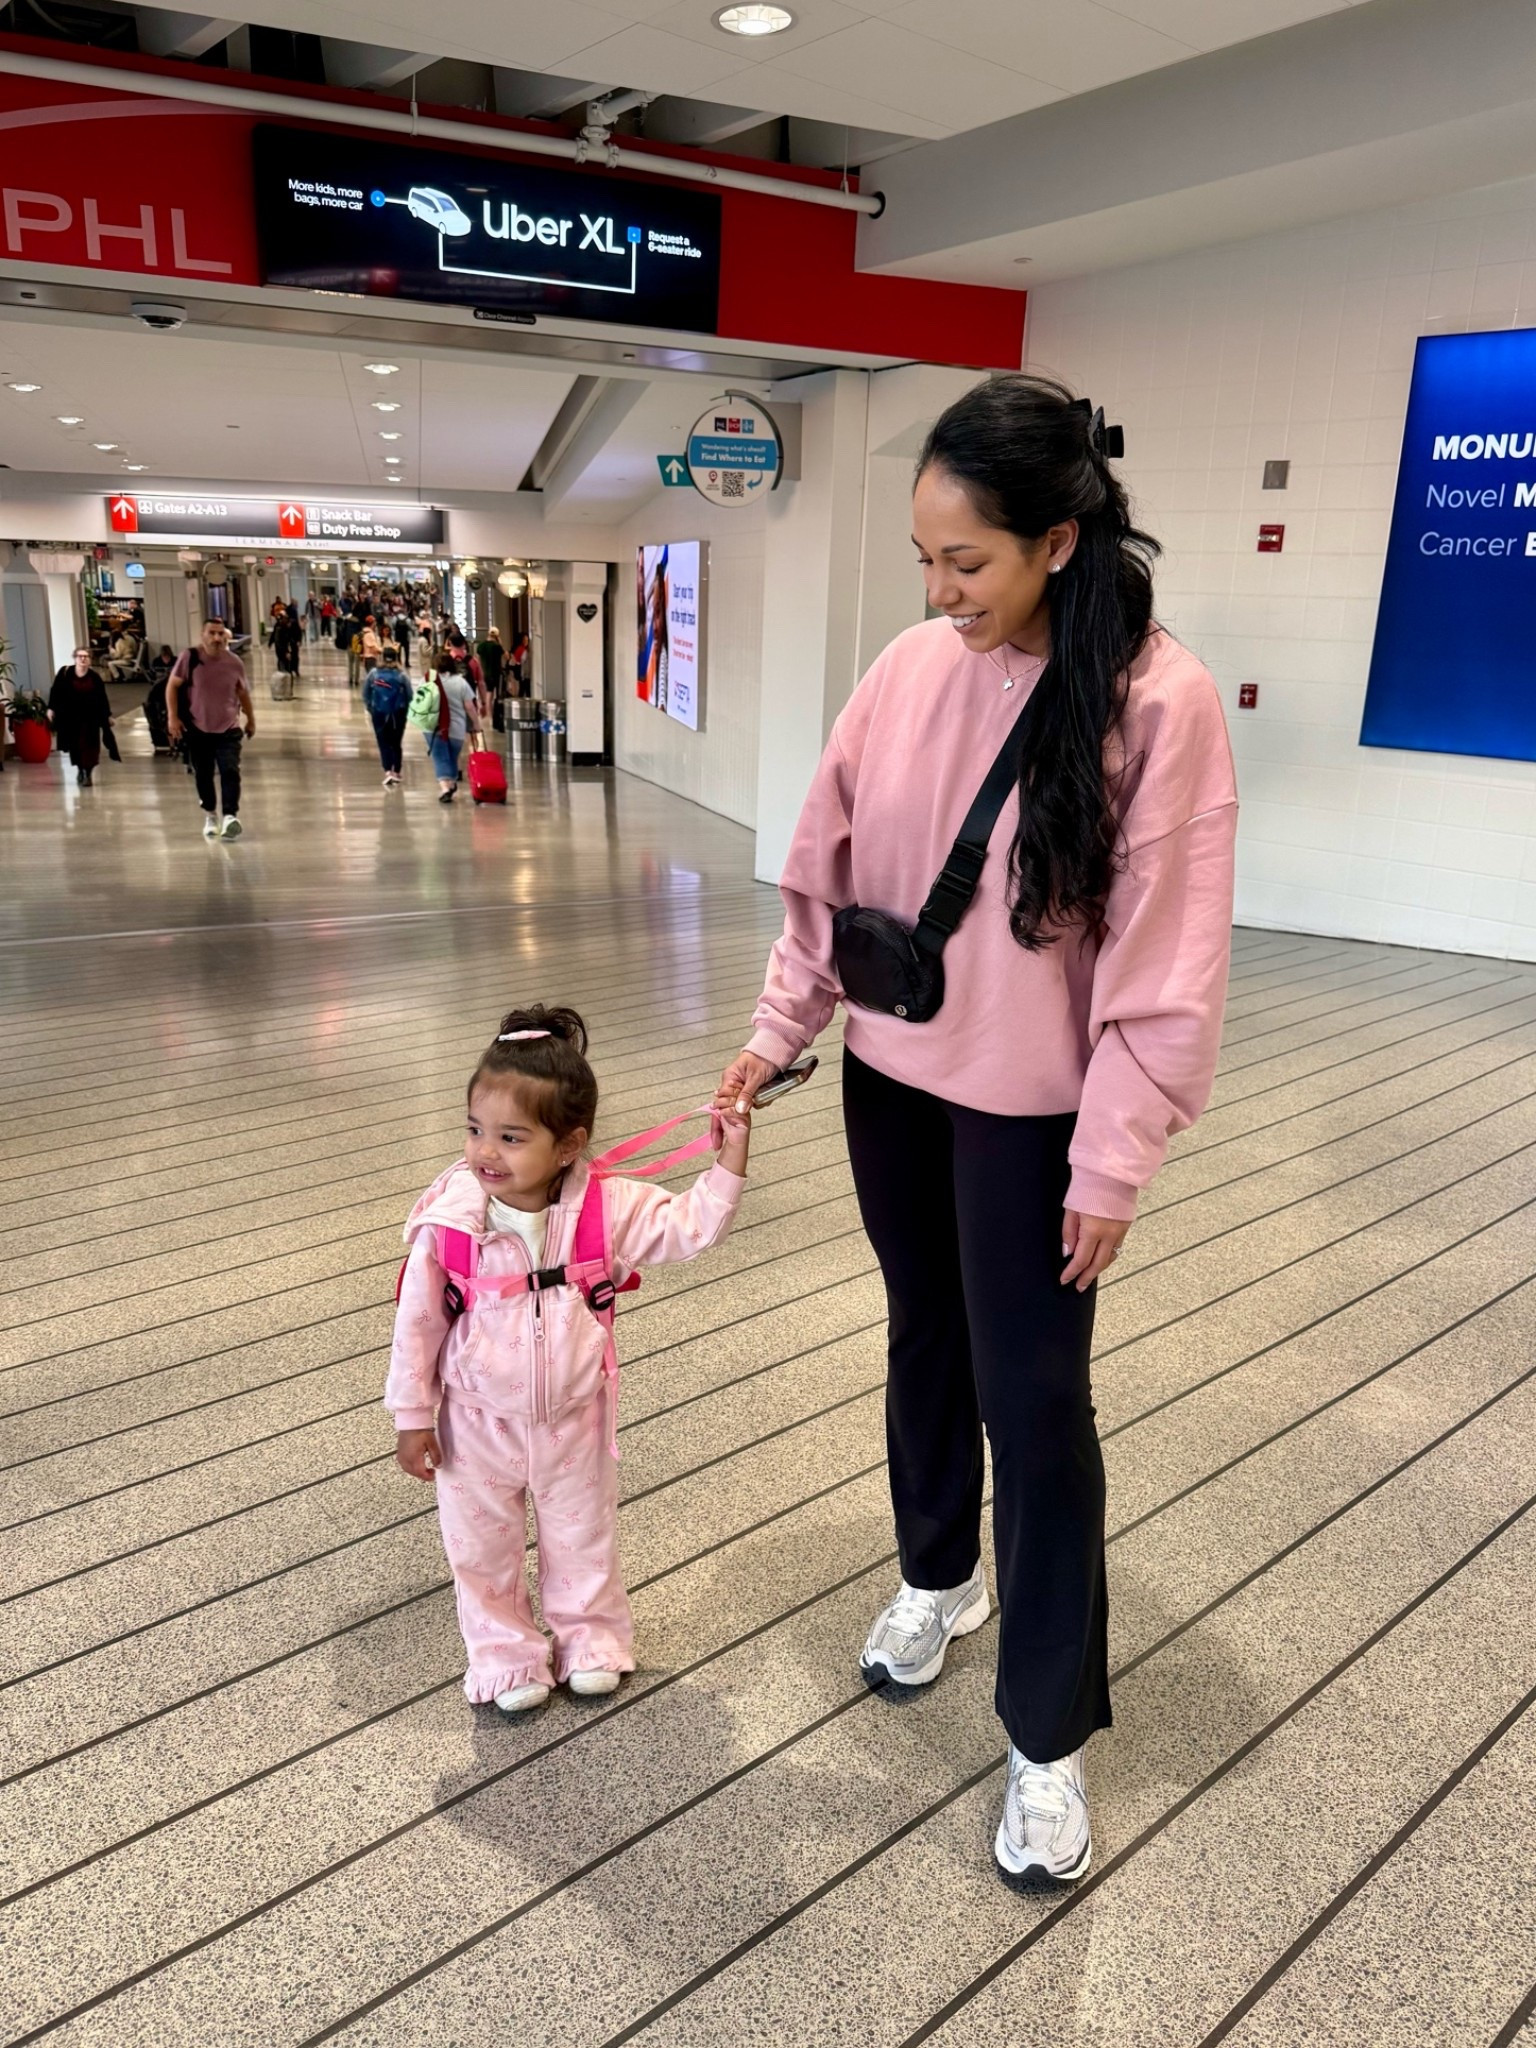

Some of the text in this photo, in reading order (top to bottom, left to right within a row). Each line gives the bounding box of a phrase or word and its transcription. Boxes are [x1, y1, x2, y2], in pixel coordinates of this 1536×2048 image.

[288, 178, 363, 199] More kids, more
[294, 191, 364, 211] bags, more car
[3, 187, 232, 274] PHL
[482, 199, 625, 255] Uber XL
[648, 230, 690, 246] Request a
[648, 241, 702, 258] 6-seater ride
[1432, 432, 1536, 460] MONU
[701, 452, 717, 461] Find
[718, 453, 743, 463] Where
[753, 454, 766, 464] Eat
[1426, 483, 1506, 508] Novel
[155, 502, 228, 516] Gates A2-A13
[322, 508, 372, 522] Snack Bar
[322, 523, 401, 539] Duty Free Shop
[235, 537, 298, 547] TERMINAL
[1419, 531, 1518, 556] Cancer
